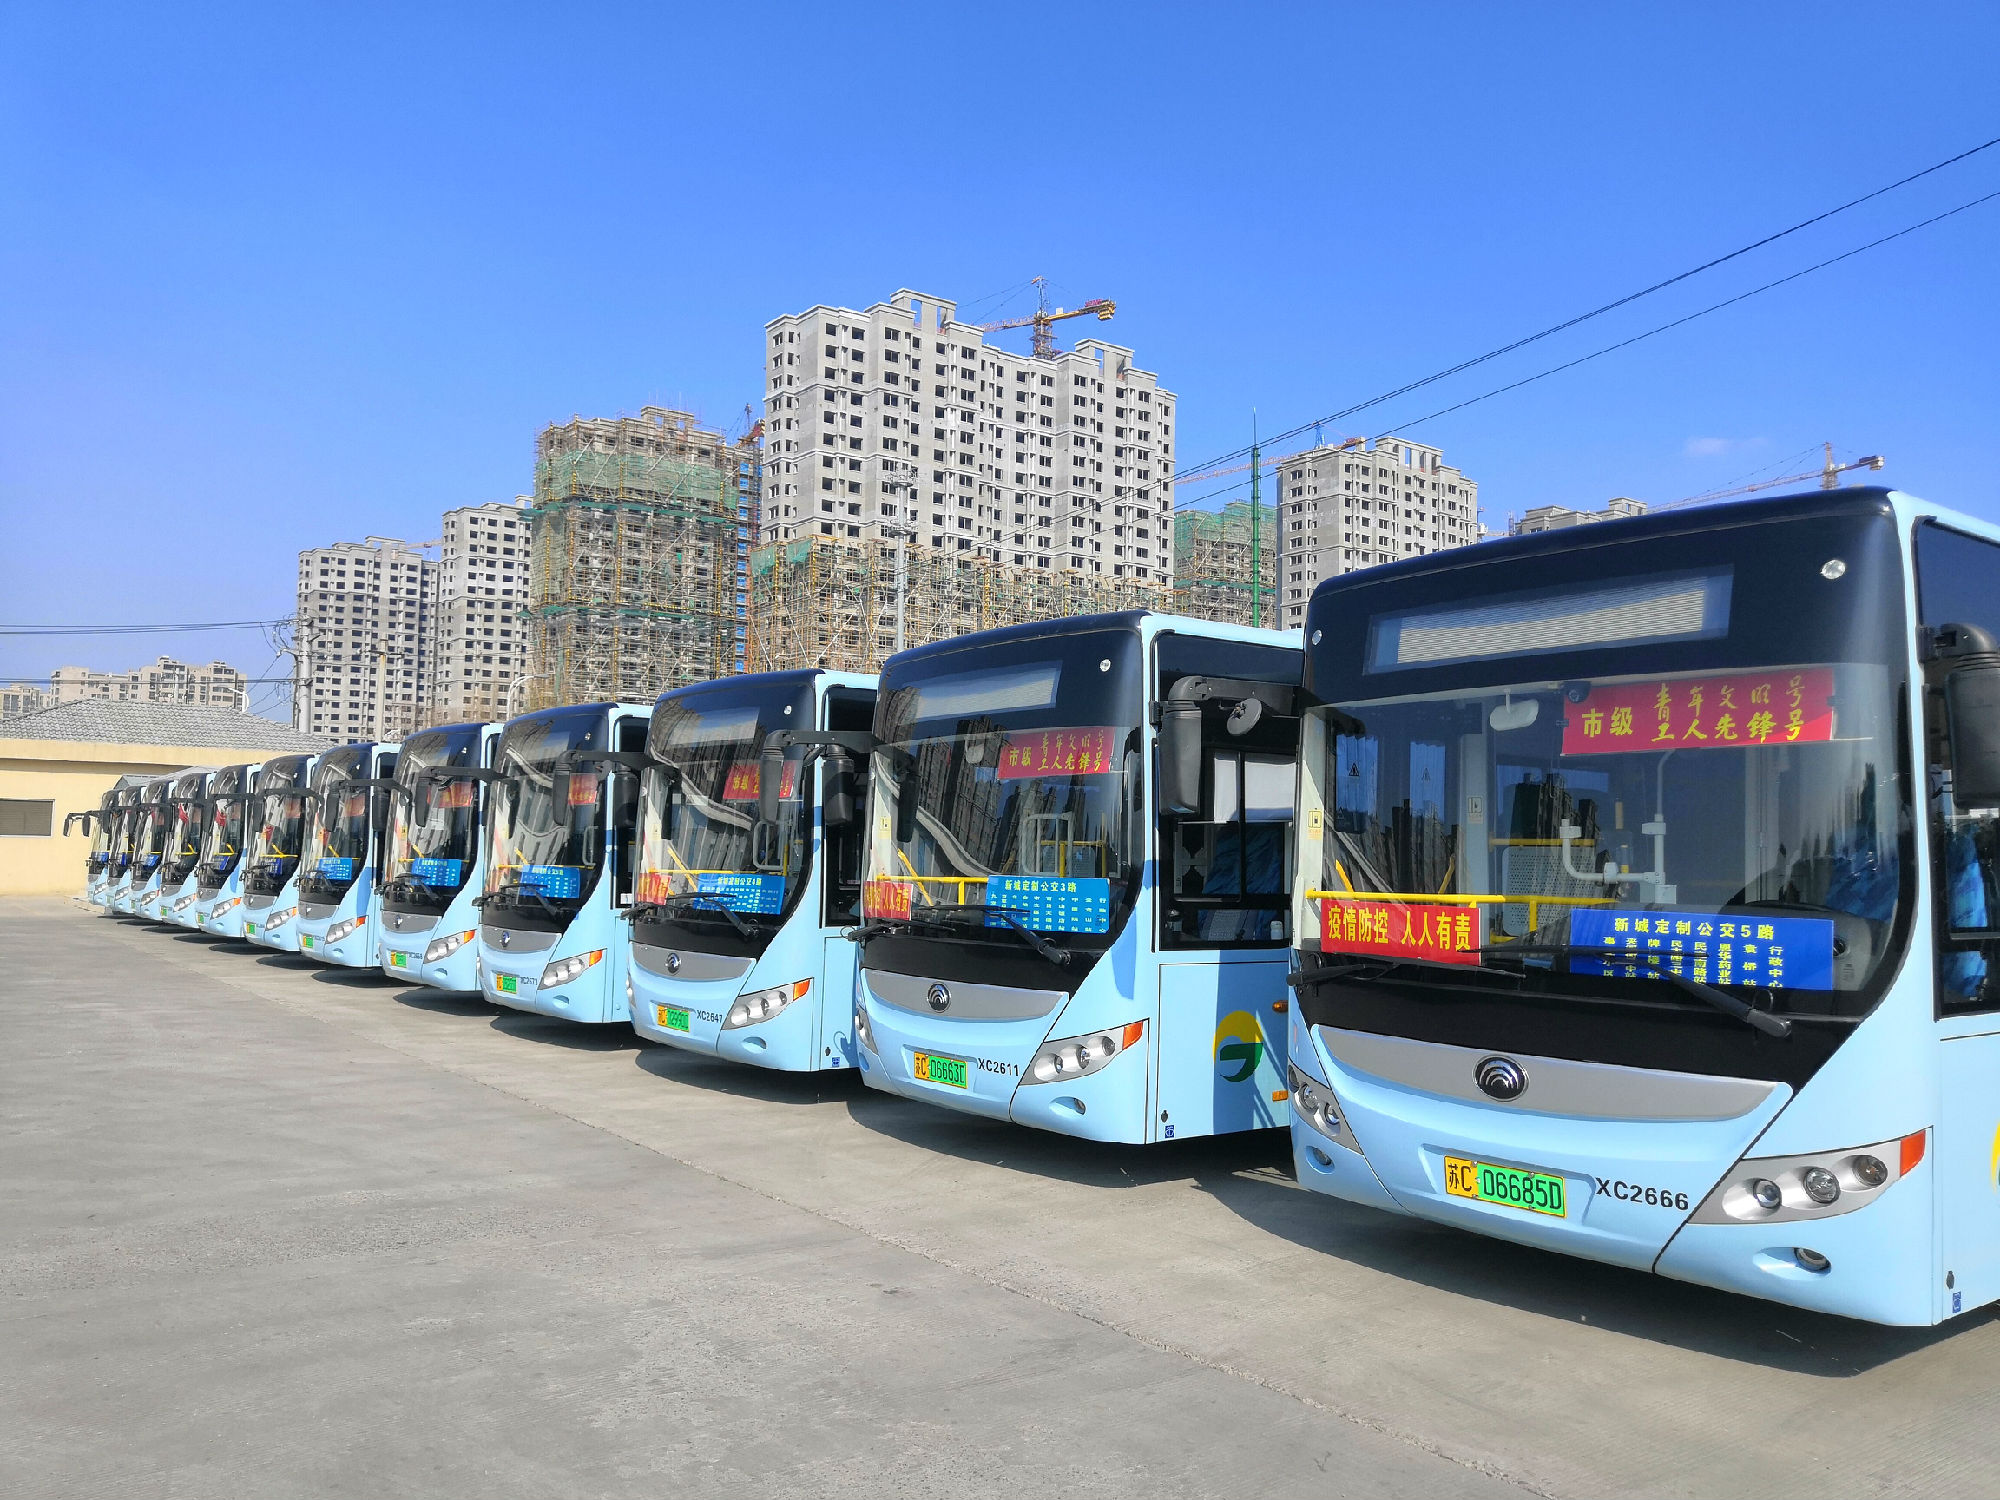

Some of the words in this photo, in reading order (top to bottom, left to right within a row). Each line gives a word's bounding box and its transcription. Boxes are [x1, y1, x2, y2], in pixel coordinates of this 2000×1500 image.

[1653, 674, 1806, 722] 青年文明号
[1581, 706, 1634, 738] 市级
[1651, 708, 1805, 744] 工人先锋号
[1009, 746, 1032, 767] 市级
[1328, 904, 1389, 944] 疫情防控
[1401, 910, 1471, 951] 人人有责
[1614, 917, 1775, 941] 新城定制公交5路
[978, 1058, 1019, 1077] XC2611
[1595, 1177, 1689, 1210] XC2666
